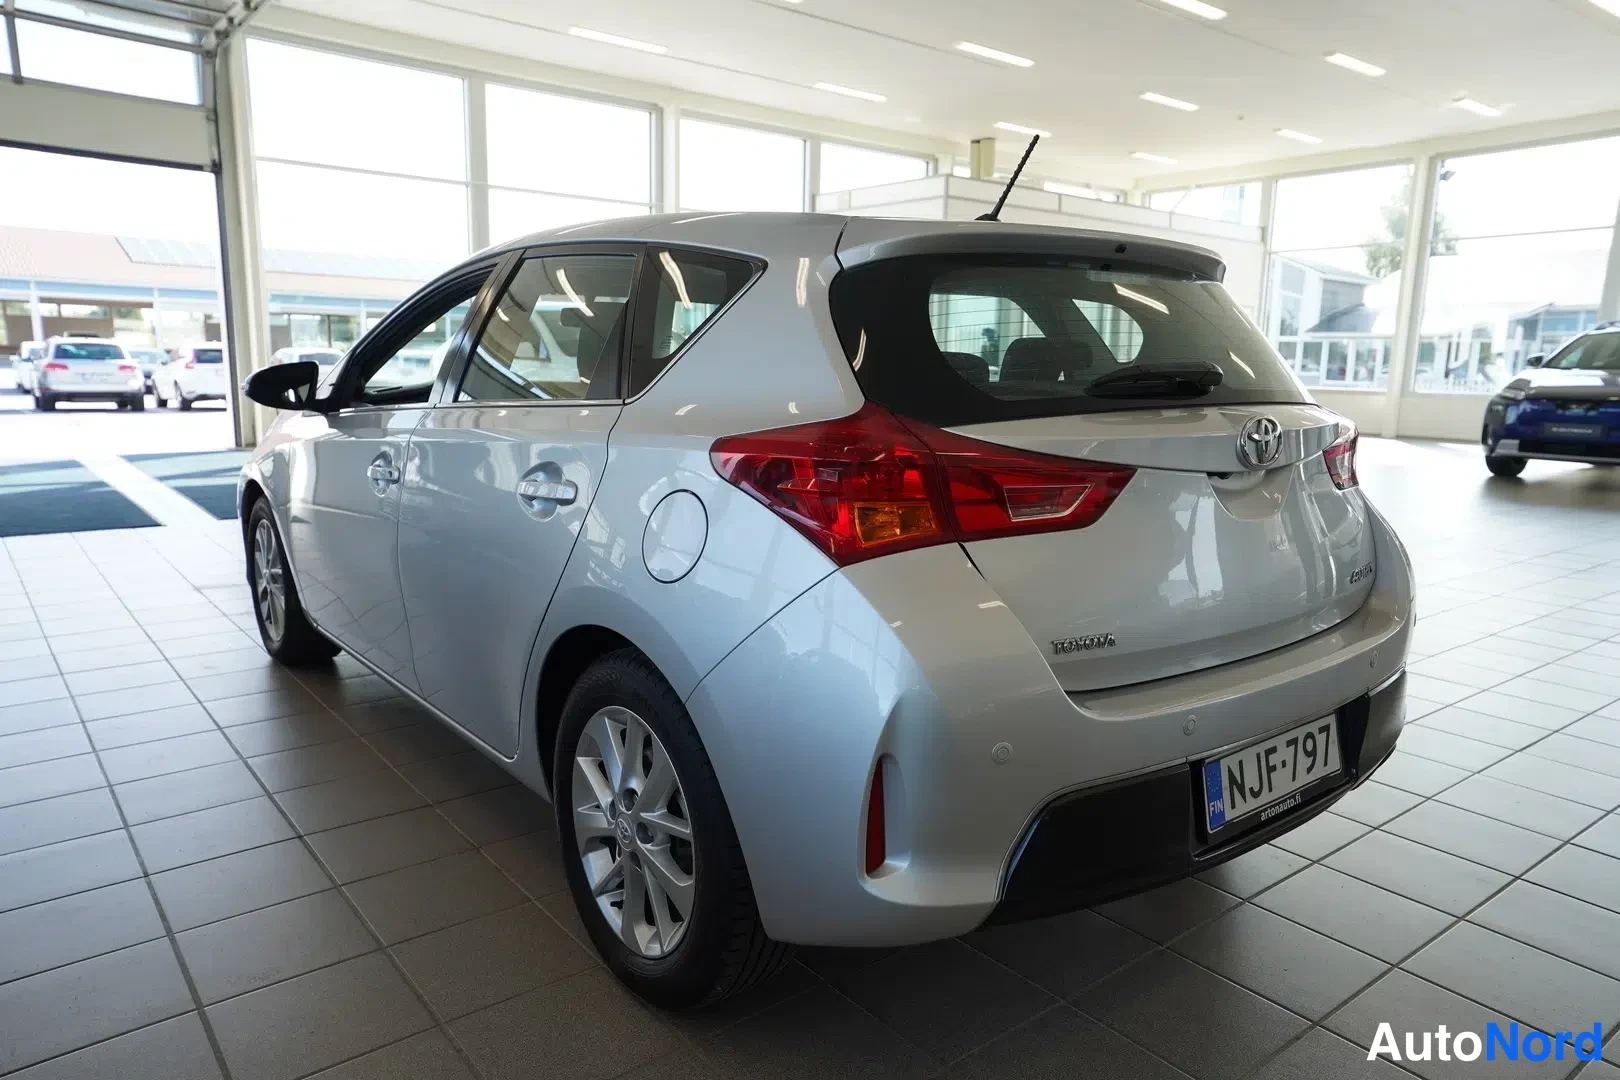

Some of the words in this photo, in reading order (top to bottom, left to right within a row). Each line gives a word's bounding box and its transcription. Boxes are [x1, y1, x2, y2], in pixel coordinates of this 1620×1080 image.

[1051, 632, 1117, 655] TOYOTA
[1227, 723, 1331, 810] NJF-797
[1209, 798, 1224, 817] FIN
[1260, 792, 1302, 821] artonauto.fi
